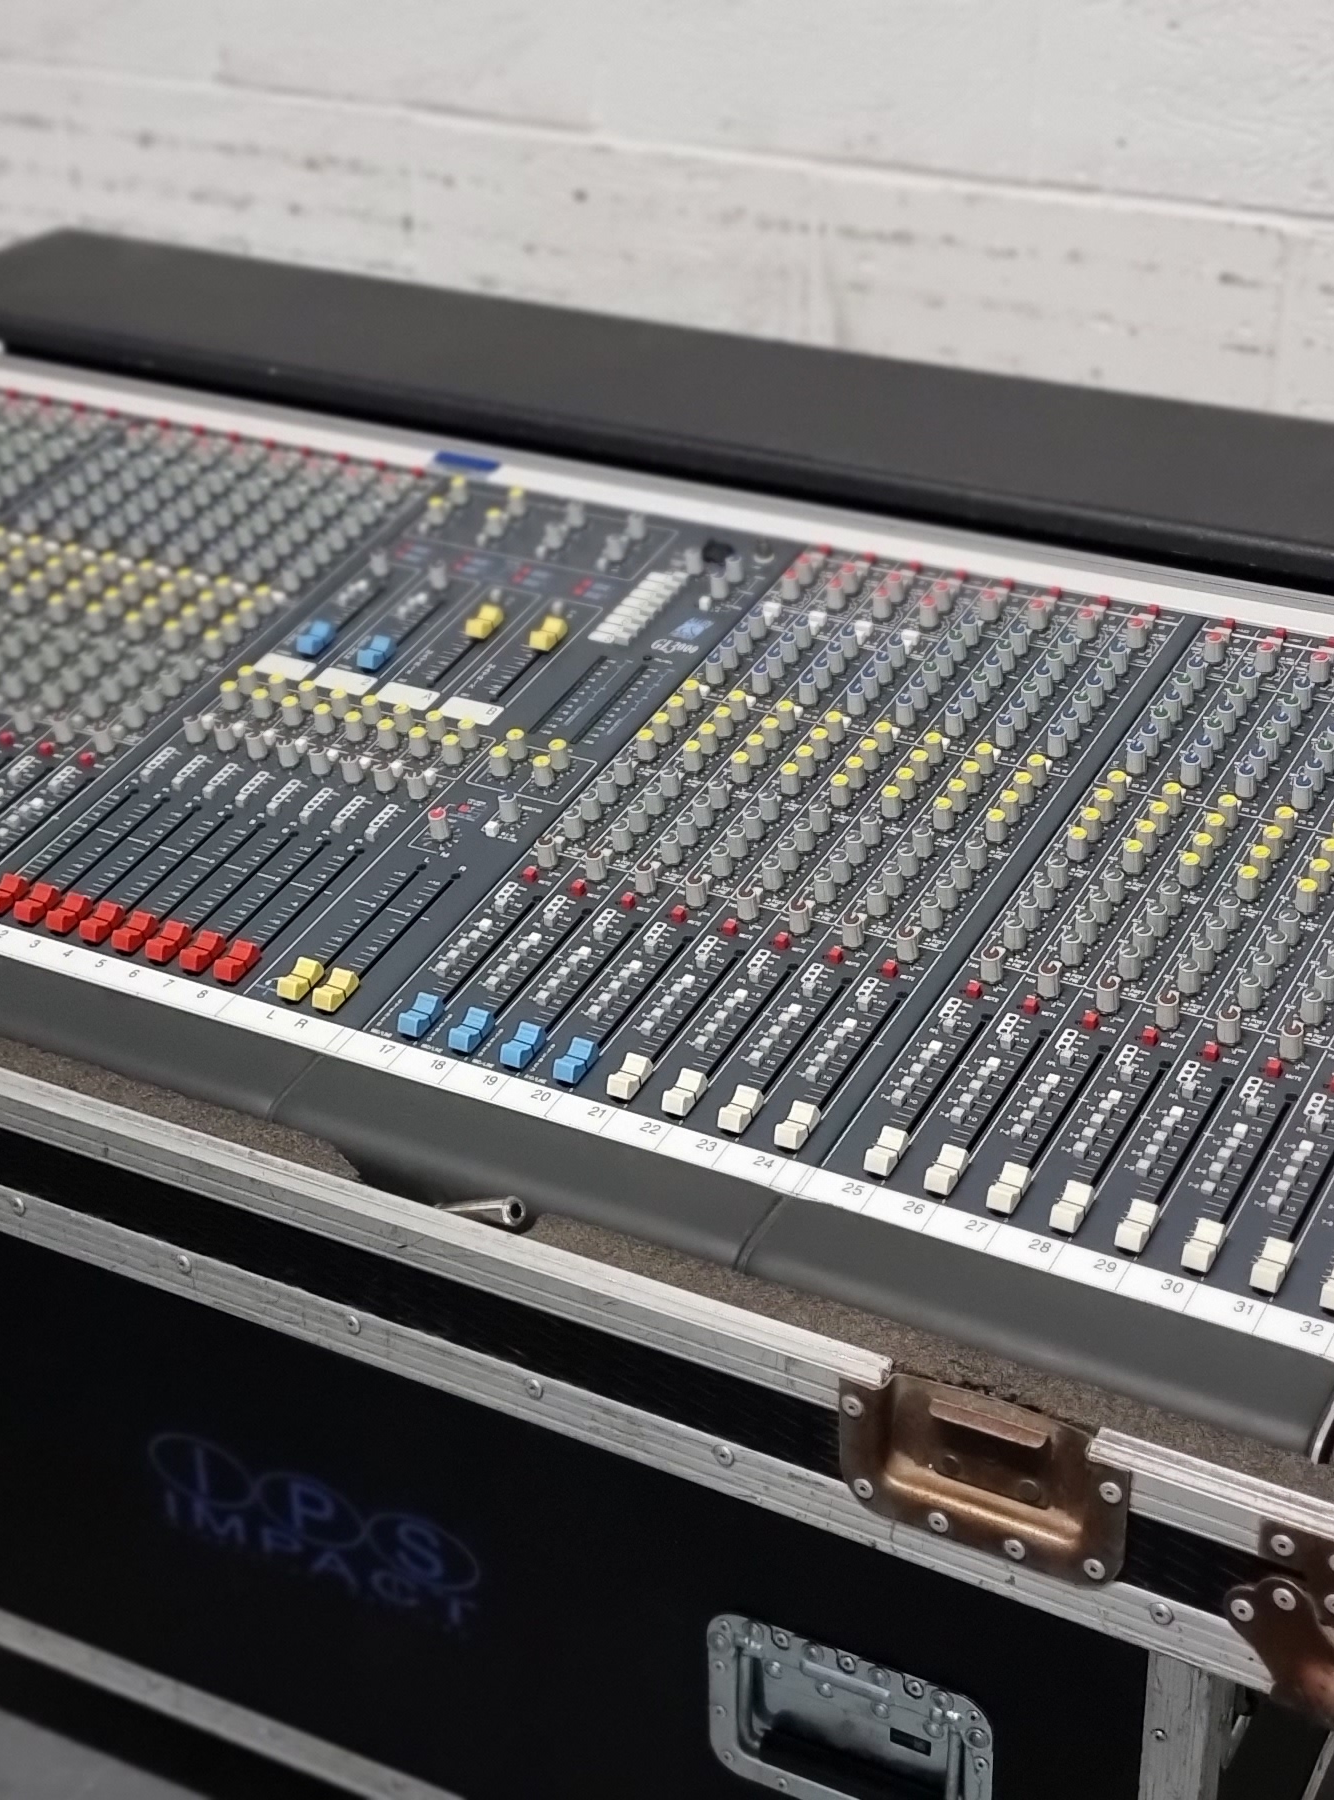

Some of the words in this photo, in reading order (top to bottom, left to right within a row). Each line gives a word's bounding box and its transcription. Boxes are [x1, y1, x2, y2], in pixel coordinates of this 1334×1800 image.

[651, 638, 699, 654] GL3000
[29, 939, 42, 949] 3
[62, 949, 74, 958] 4
[94, 958, 108, 968] 5
[128, 969, 141, 978] 6
[162, 978, 176, 988] 7
[196, 989, 209, 999] 8
[265, 1009, 275, 1020] L
[294, 1018, 309, 1029] R
[379, 1043, 397, 1054] 17
[430, 1059, 447, 1071] 18
[482, 1074, 499, 1086] 19
[530, 1089, 552, 1102] 20
[587, 1106, 607, 1119] 21
[639, 1121, 662, 1135] 22
[695, 1138, 718, 1152] 23
[752, 1155, 775, 1169] 24
[841, 1182, 865, 1196] 25
[902, 1200, 926, 1215] 26
[964, 1219, 989, 1233] 27
[1028, 1238, 1052, 1254] 28
[1093, 1258, 1118, 1273] 29
[1160, 1278, 1185, 1294] 30
[1233, 1300, 1255, 1316] 31
[1299, 1320, 1324, 1337] 32
